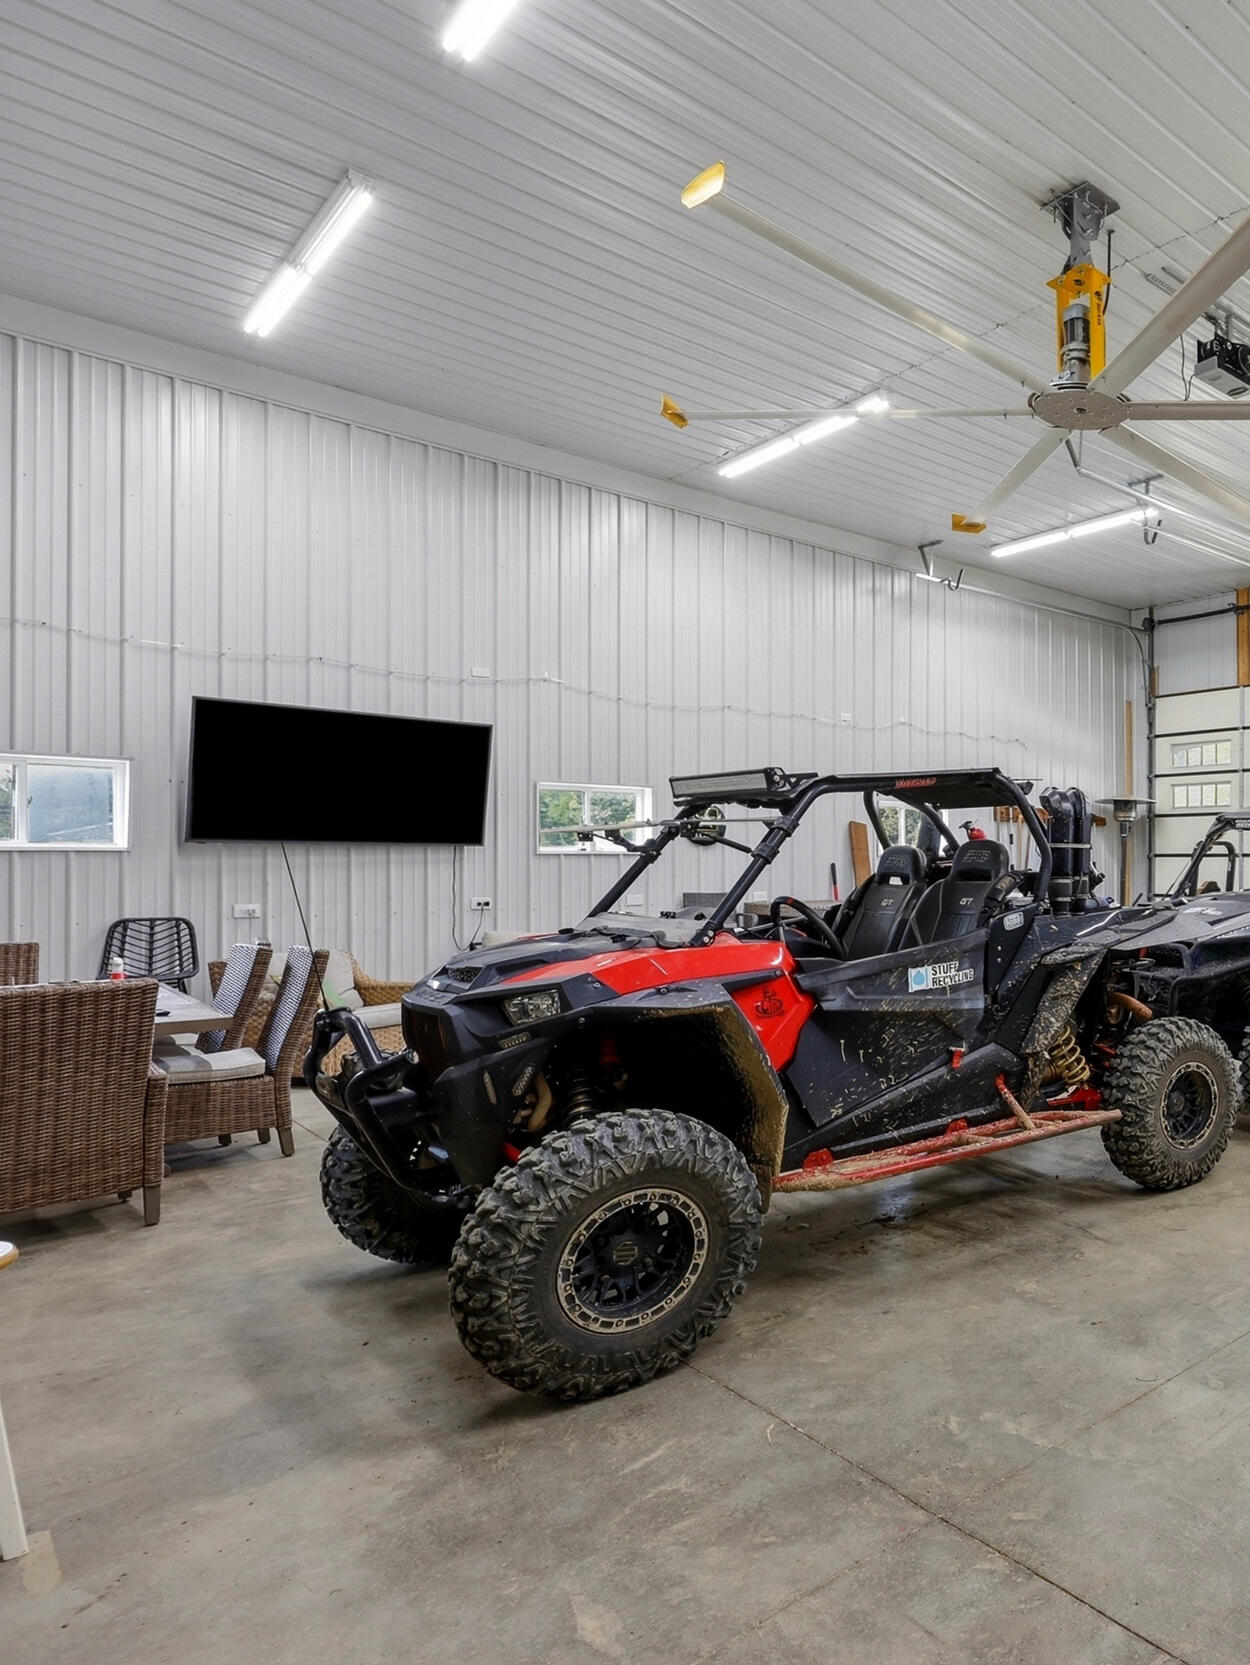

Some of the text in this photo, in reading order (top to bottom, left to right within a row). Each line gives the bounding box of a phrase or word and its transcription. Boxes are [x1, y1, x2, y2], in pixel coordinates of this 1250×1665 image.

[881, 898, 894, 906] GT
[960, 897, 974, 906] GT
[931, 969, 973, 987] RECYCLING
